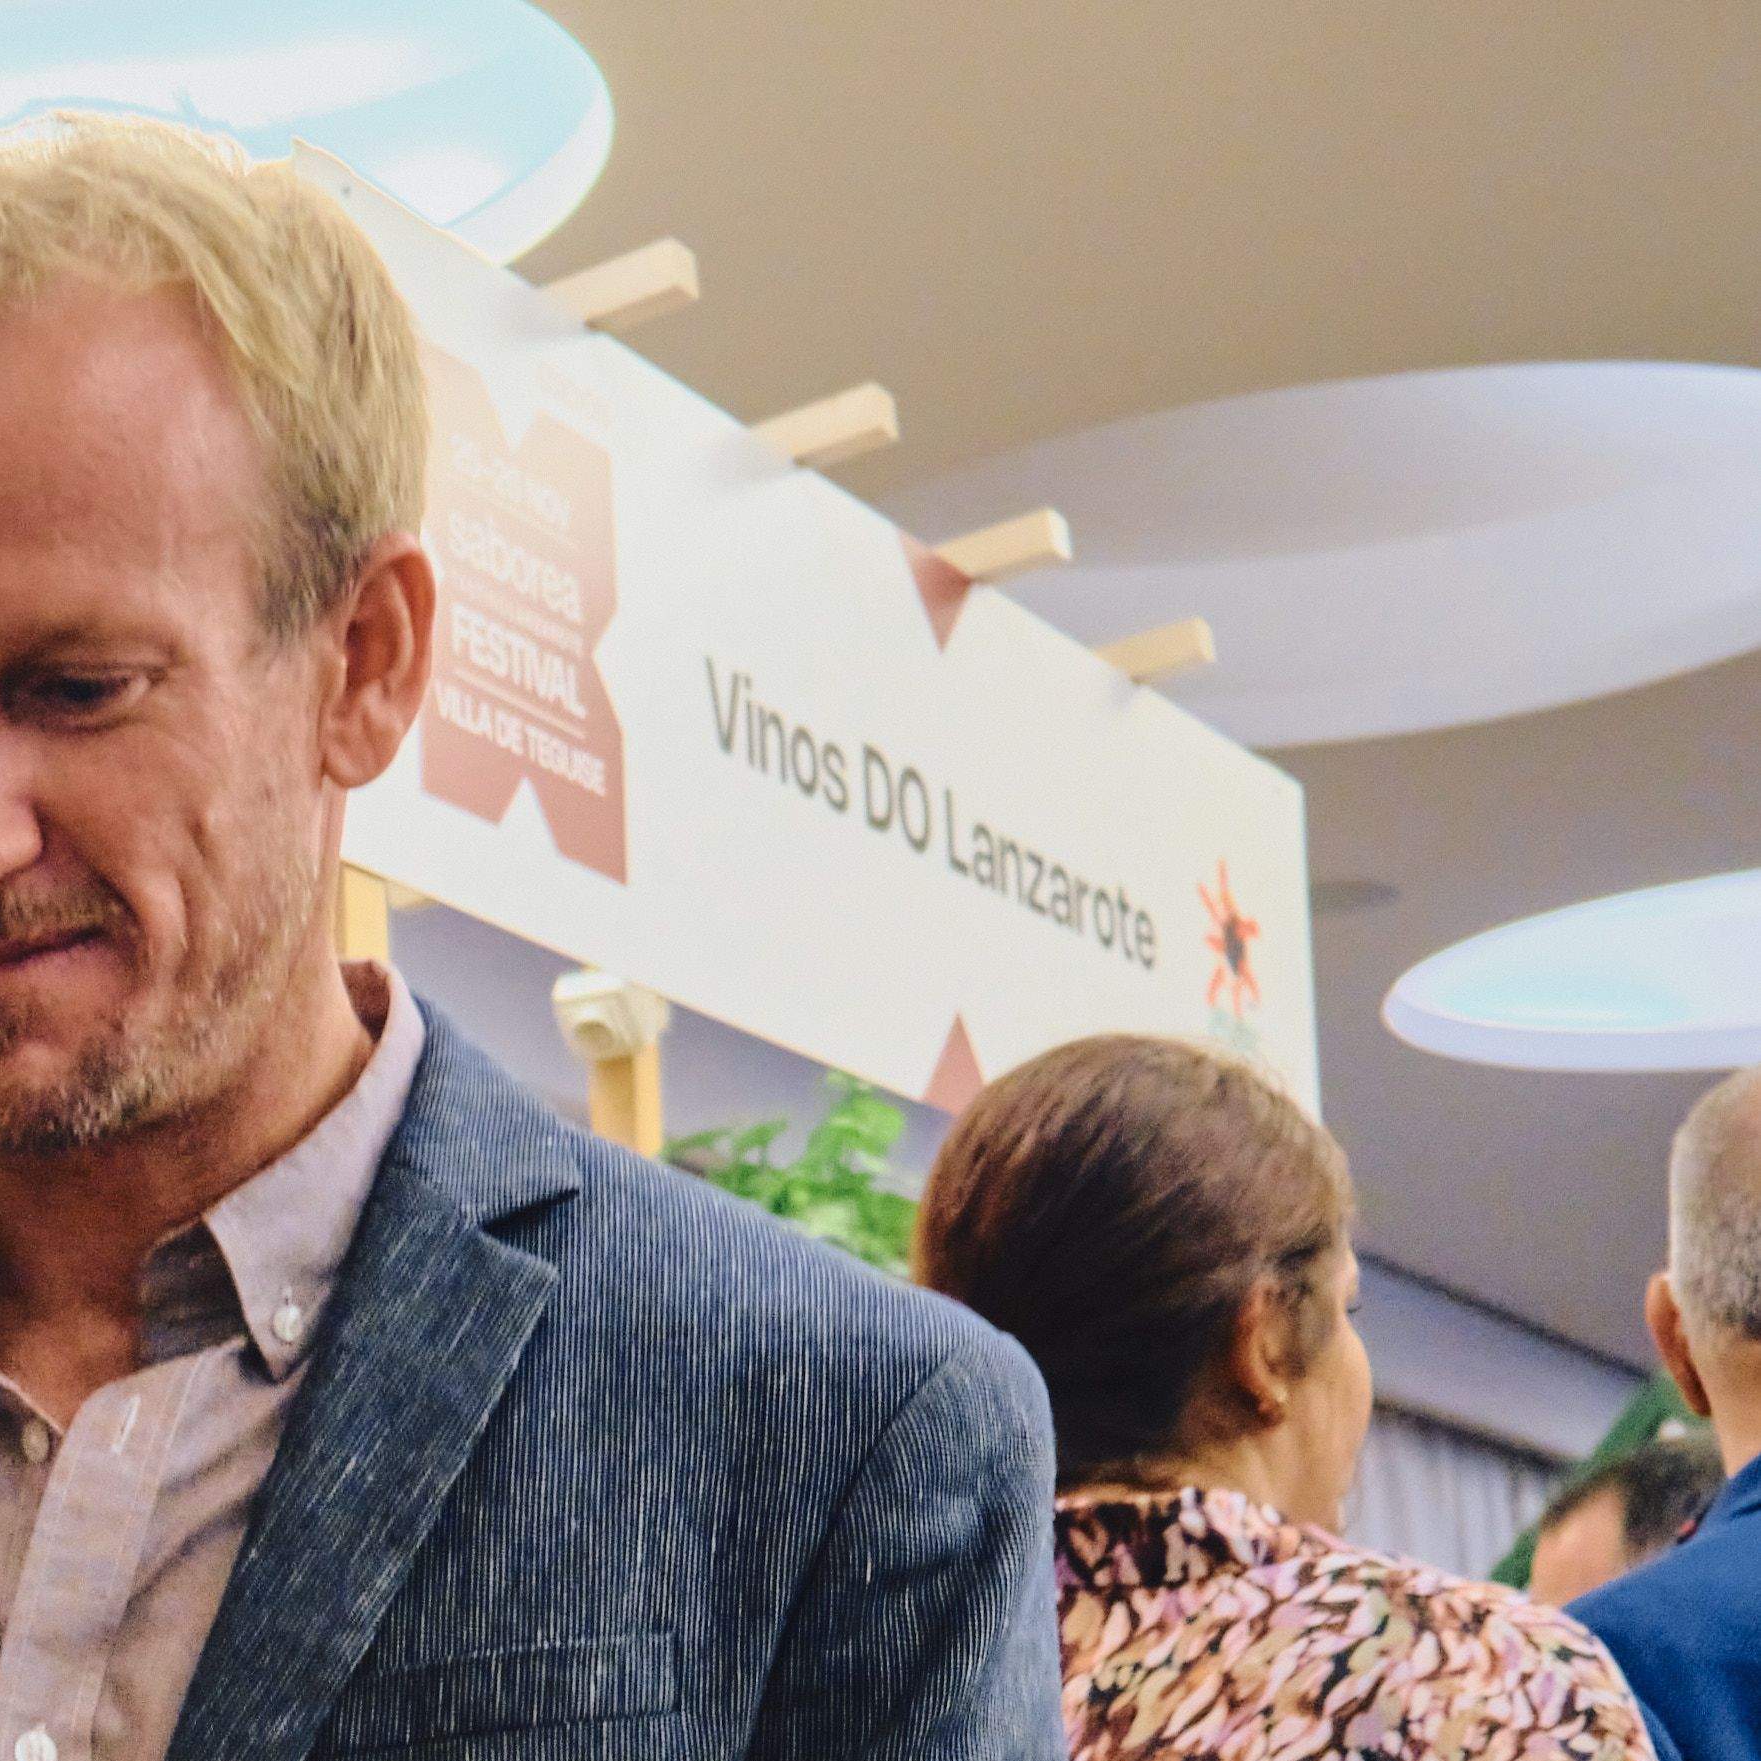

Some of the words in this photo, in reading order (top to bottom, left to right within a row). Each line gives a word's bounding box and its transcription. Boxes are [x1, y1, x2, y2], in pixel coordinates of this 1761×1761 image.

[434, 677, 498, 746] VILLA
[493, 708, 525, 758] DE
[449, 602, 588, 720] FESTIVAL
[705, 655, 850, 815] Vinos
[863, 742, 931, 855] DO
[944, 786, 1159, 971] Lanzarote
